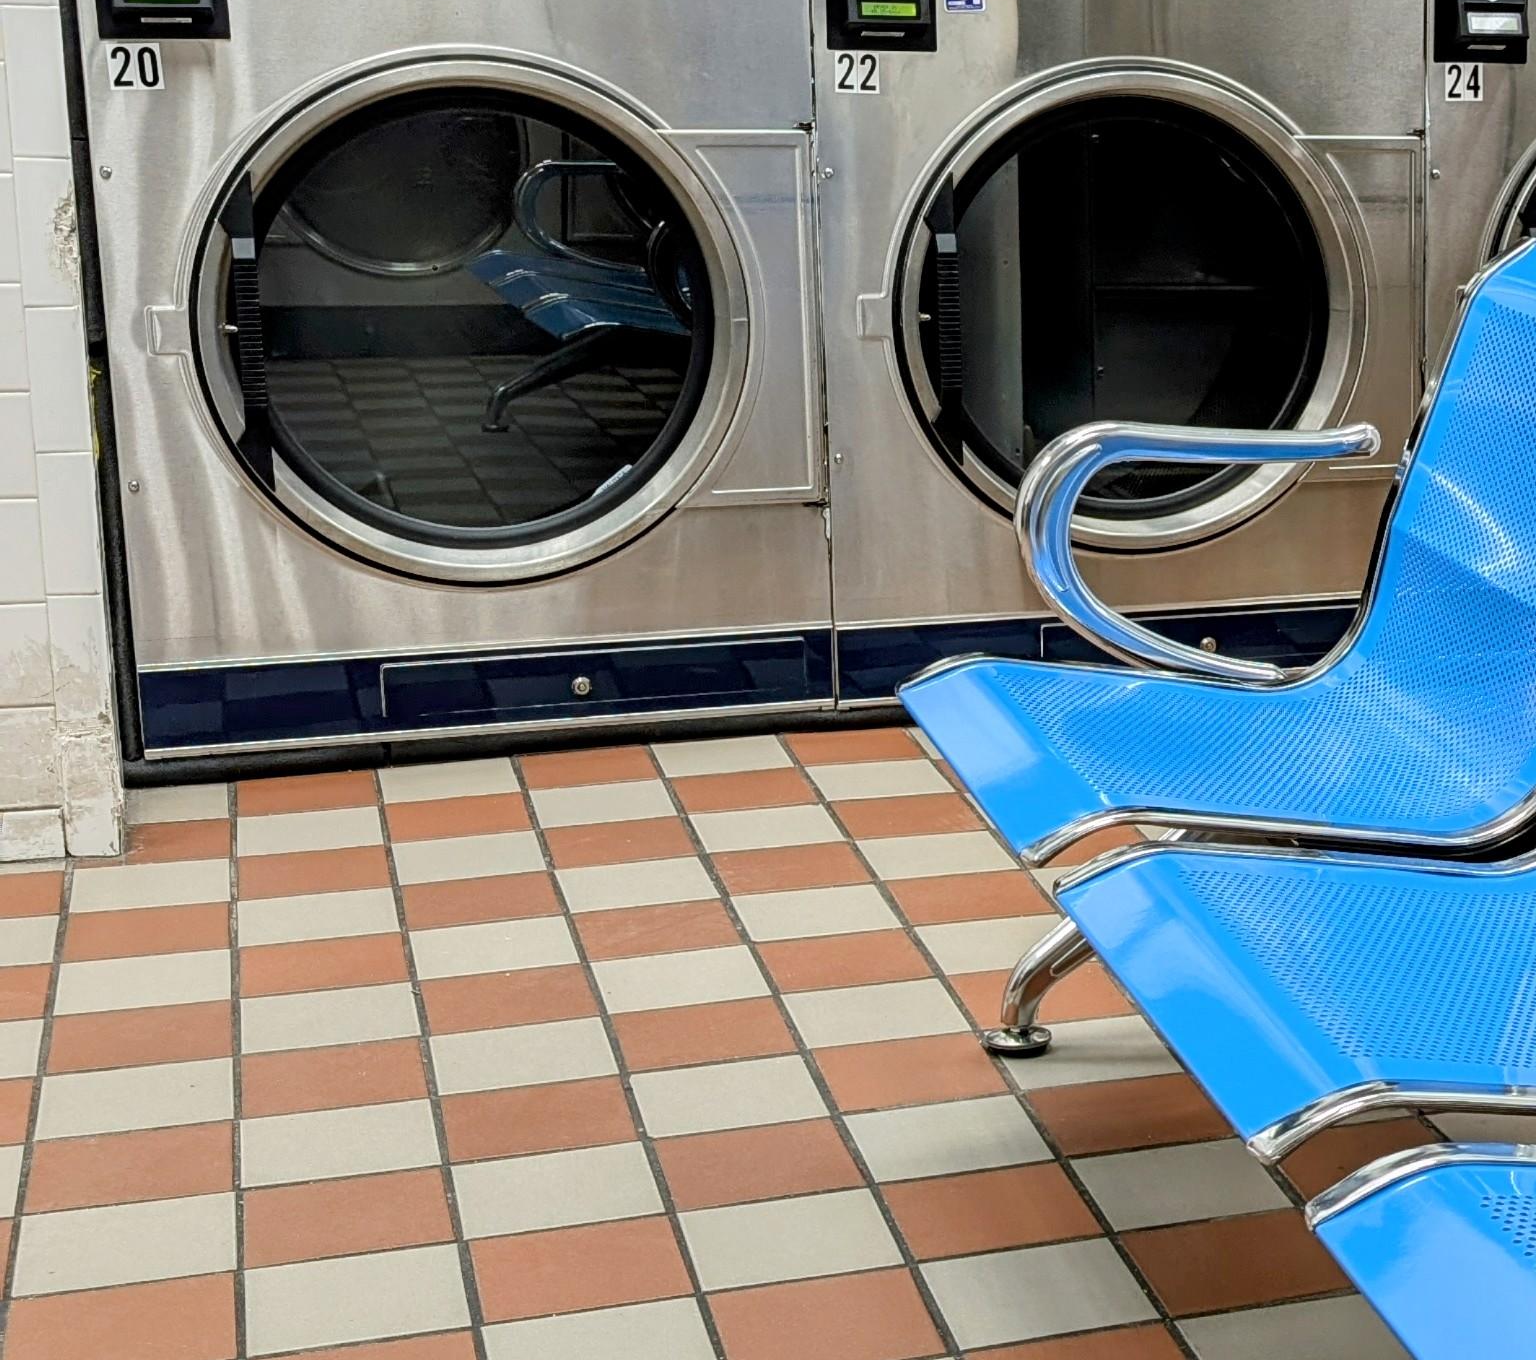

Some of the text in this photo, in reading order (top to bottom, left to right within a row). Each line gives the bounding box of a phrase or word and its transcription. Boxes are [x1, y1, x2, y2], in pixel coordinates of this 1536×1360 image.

[110, 46, 160, 88] 20
[837, 53, 877, 91] 22
[1447, 64, 1480, 99] 24
